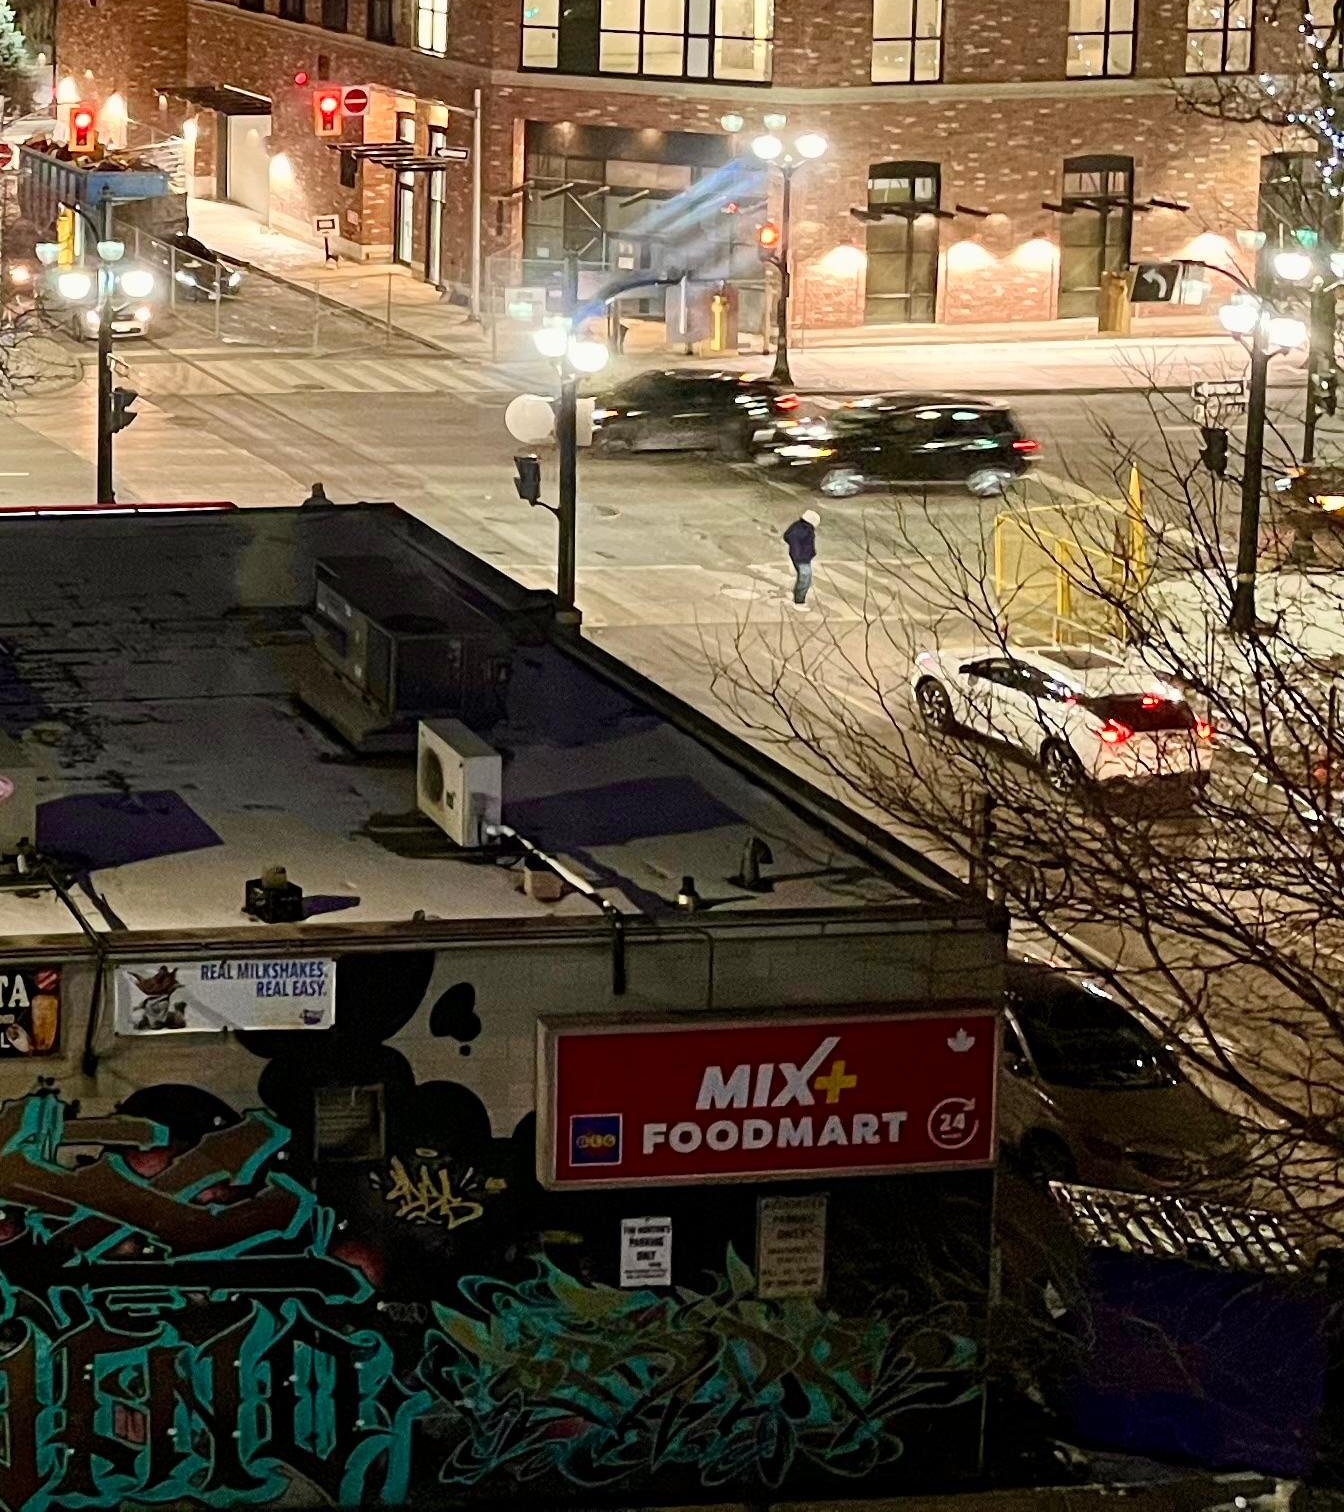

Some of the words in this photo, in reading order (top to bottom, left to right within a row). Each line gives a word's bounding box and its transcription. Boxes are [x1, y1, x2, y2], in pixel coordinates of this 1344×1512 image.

[201, 964, 234, 981] REAL
[237, 961, 328, 981] MILKSHAKES.
[256, 981, 290, 998] REAL
[292, 980, 327, 997] EASY.
[938, 1110, 967, 1133] 24
[642, 1110, 909, 1156] FOODMART
